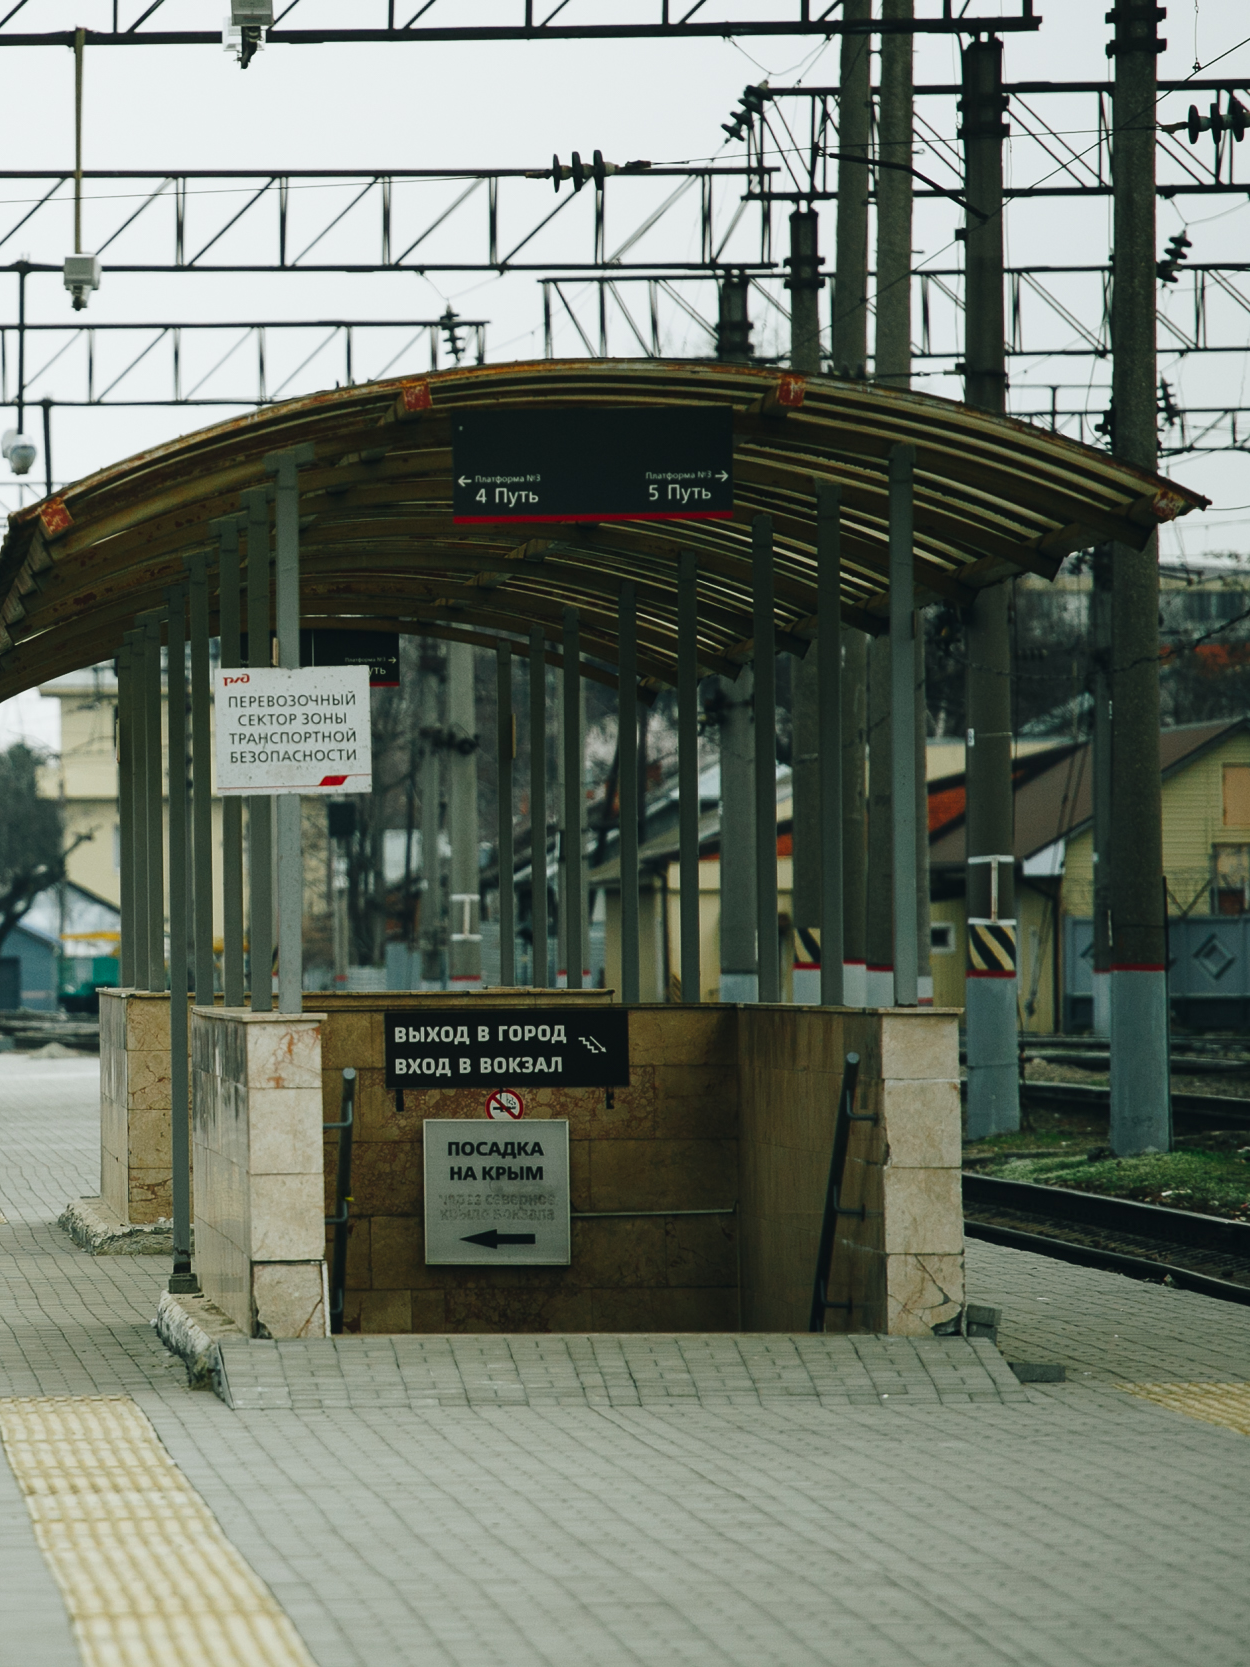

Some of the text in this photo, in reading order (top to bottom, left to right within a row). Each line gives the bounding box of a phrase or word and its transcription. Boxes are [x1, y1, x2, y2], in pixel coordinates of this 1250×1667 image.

[475, 474, 541, 485] Платформа №3
[645, 470, 712, 482] Платформа №3
[475, 488, 539, 508] 4 Путь
[648, 484, 712, 504] 5 Путь
[368, 667, 386, 676] уть
[228, 690, 356, 708] ПЕРЕВОЗОЧНЫЙ
[238, 712, 347, 727] СЕКТОР ЗОНЫ
[229, 728, 357, 745] ТРАНСПОРТНОЙ
[230, 749, 357, 764] БЕЗОПАСНОСТИ
[394, 1025, 567, 1045] ВЫХОД В ГОРОД
[395, 1057, 563, 1077] ВХОД В ВОКЗАЛ
[447, 1141, 544, 1159] ПОСАДКА
[449, 1166, 544, 1181] НА КРЫМ
